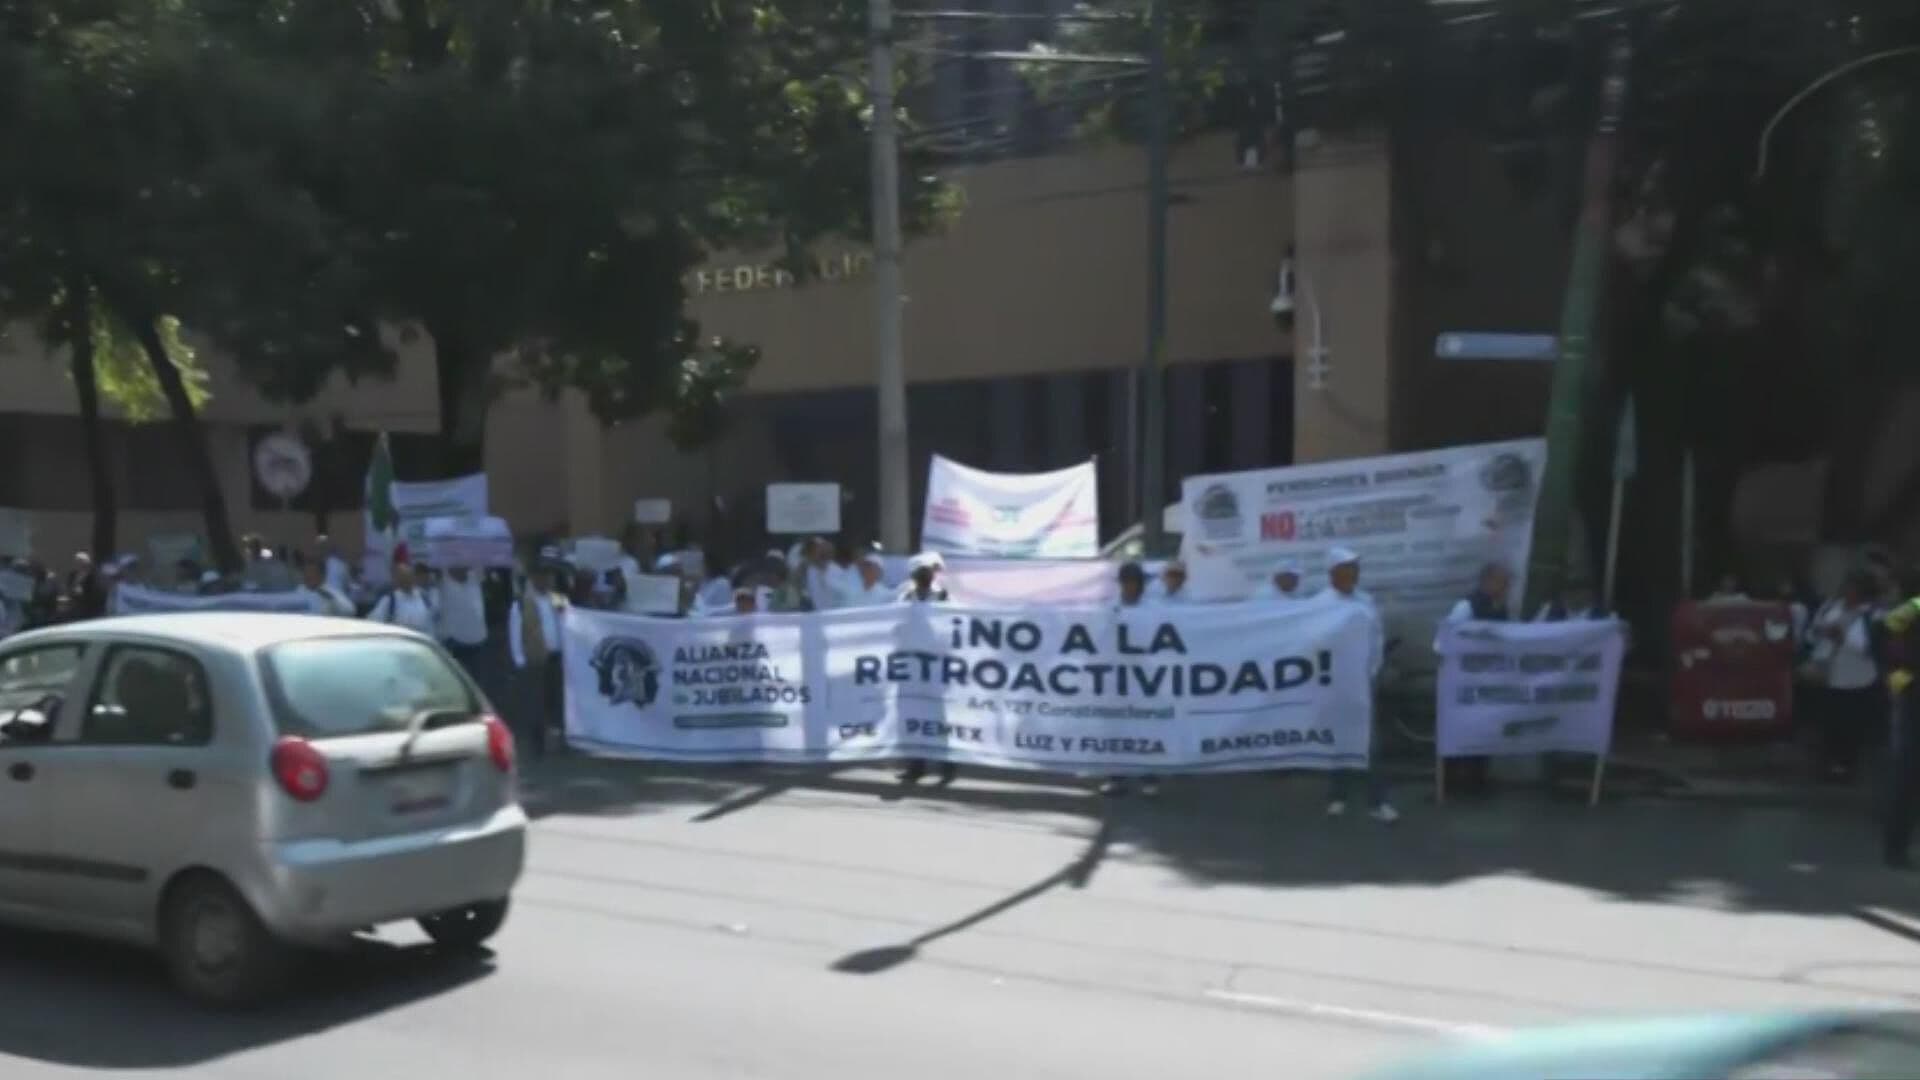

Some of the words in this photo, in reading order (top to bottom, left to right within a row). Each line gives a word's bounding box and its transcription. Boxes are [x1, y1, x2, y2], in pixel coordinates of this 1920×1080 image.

[1260, 511, 1295, 541] NO
[674, 642, 769, 662] ALIANZA
[950, 617, 1042, 653] ¡NO
[1060, 623, 1096, 655] A
[1117, 622, 1187, 655] LA
[673, 664, 786, 686] NACIONAL
[854, 650, 1332, 698] RETROACTIVIDAD!
[906, 718, 983, 742] PEMEX
[1015, 732, 1052, 751] LUZ
[1060, 736, 1072, 752] Y
[1080, 736, 1167, 755] FUERZA
[1201, 728, 1335, 755] BANOBRAS
